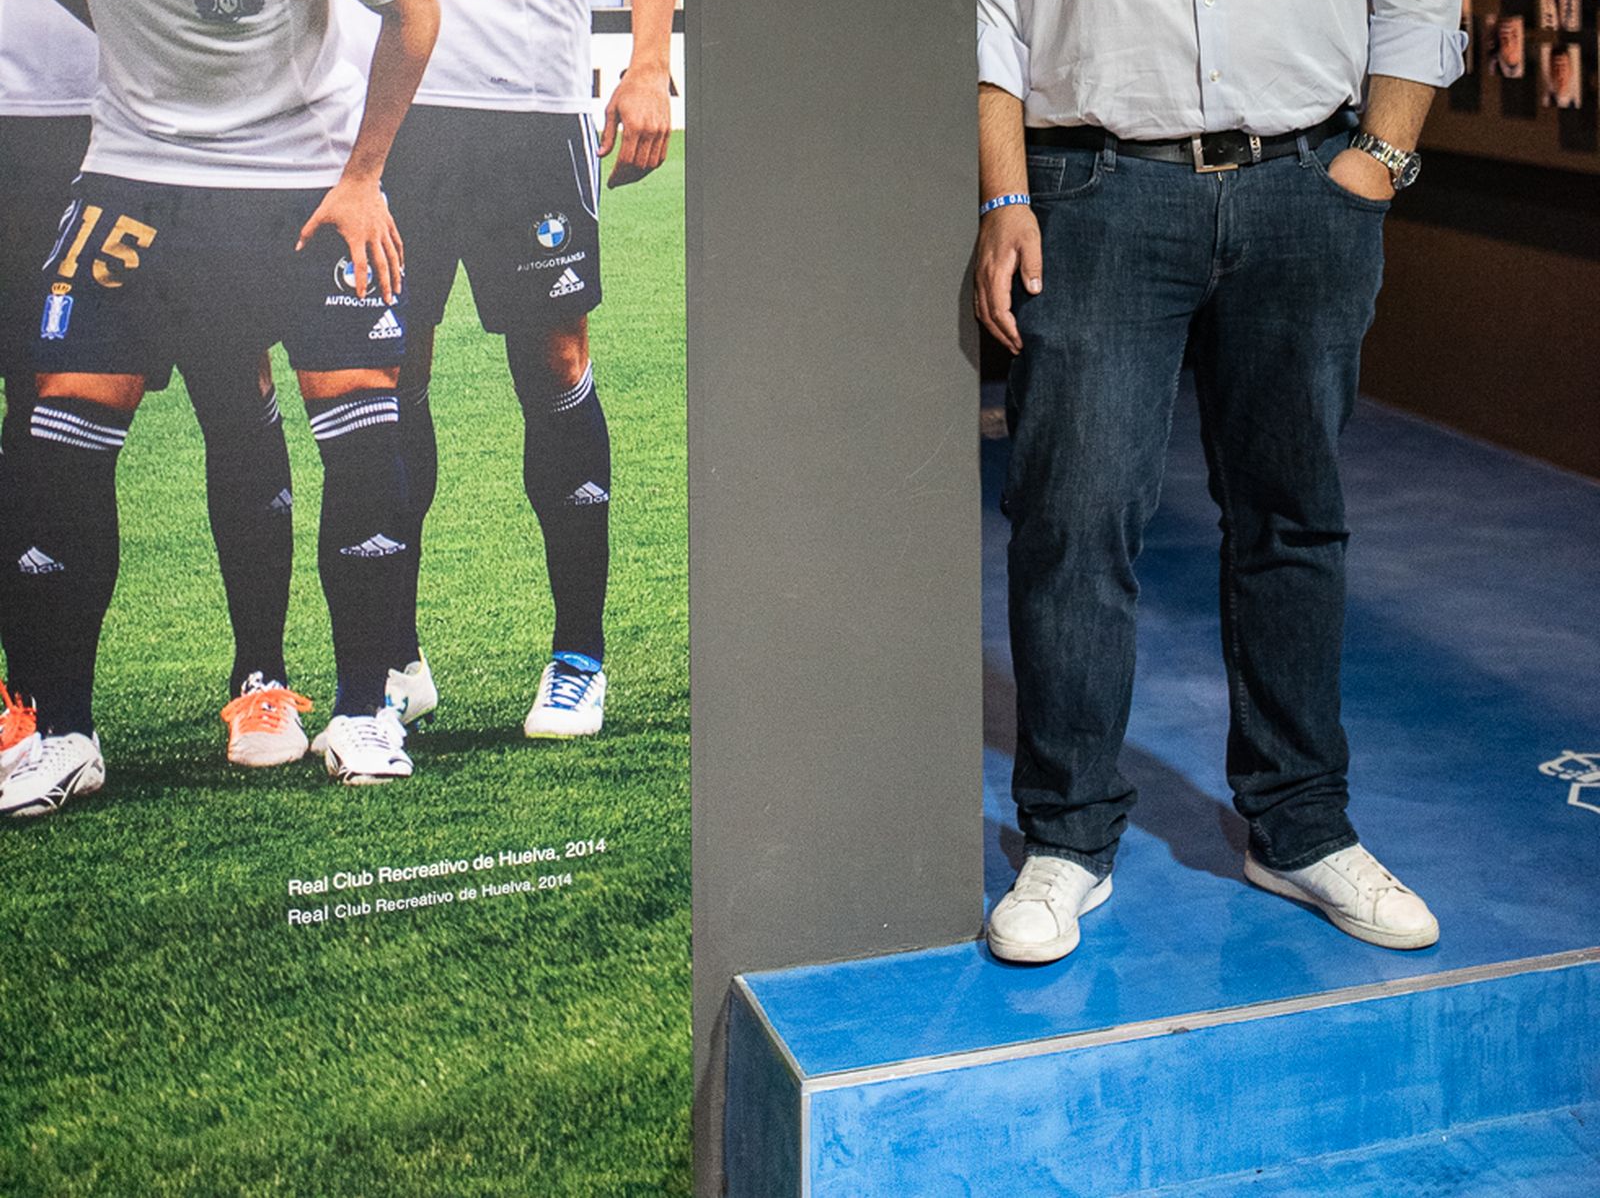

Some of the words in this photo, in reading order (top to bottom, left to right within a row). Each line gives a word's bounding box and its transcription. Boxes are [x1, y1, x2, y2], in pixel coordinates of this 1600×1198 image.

[57, 204, 158, 288] 15
[549, 281, 585, 298] adidas
[288, 876, 329, 896] Real
[333, 869, 373, 889] Club
[378, 858, 468, 883] Recreativo
[473, 853, 494, 871] de
[499, 847, 560, 867] Huelva,
[565, 838, 606, 858] 2014
[288, 905, 328, 925] Real
[335, 903, 371, 919] Club
[376, 890, 454, 912] Recreativo
[459, 887, 477, 901] de
[482, 881, 536, 898] Huelva,
[538, 873, 573, 890] 2014
